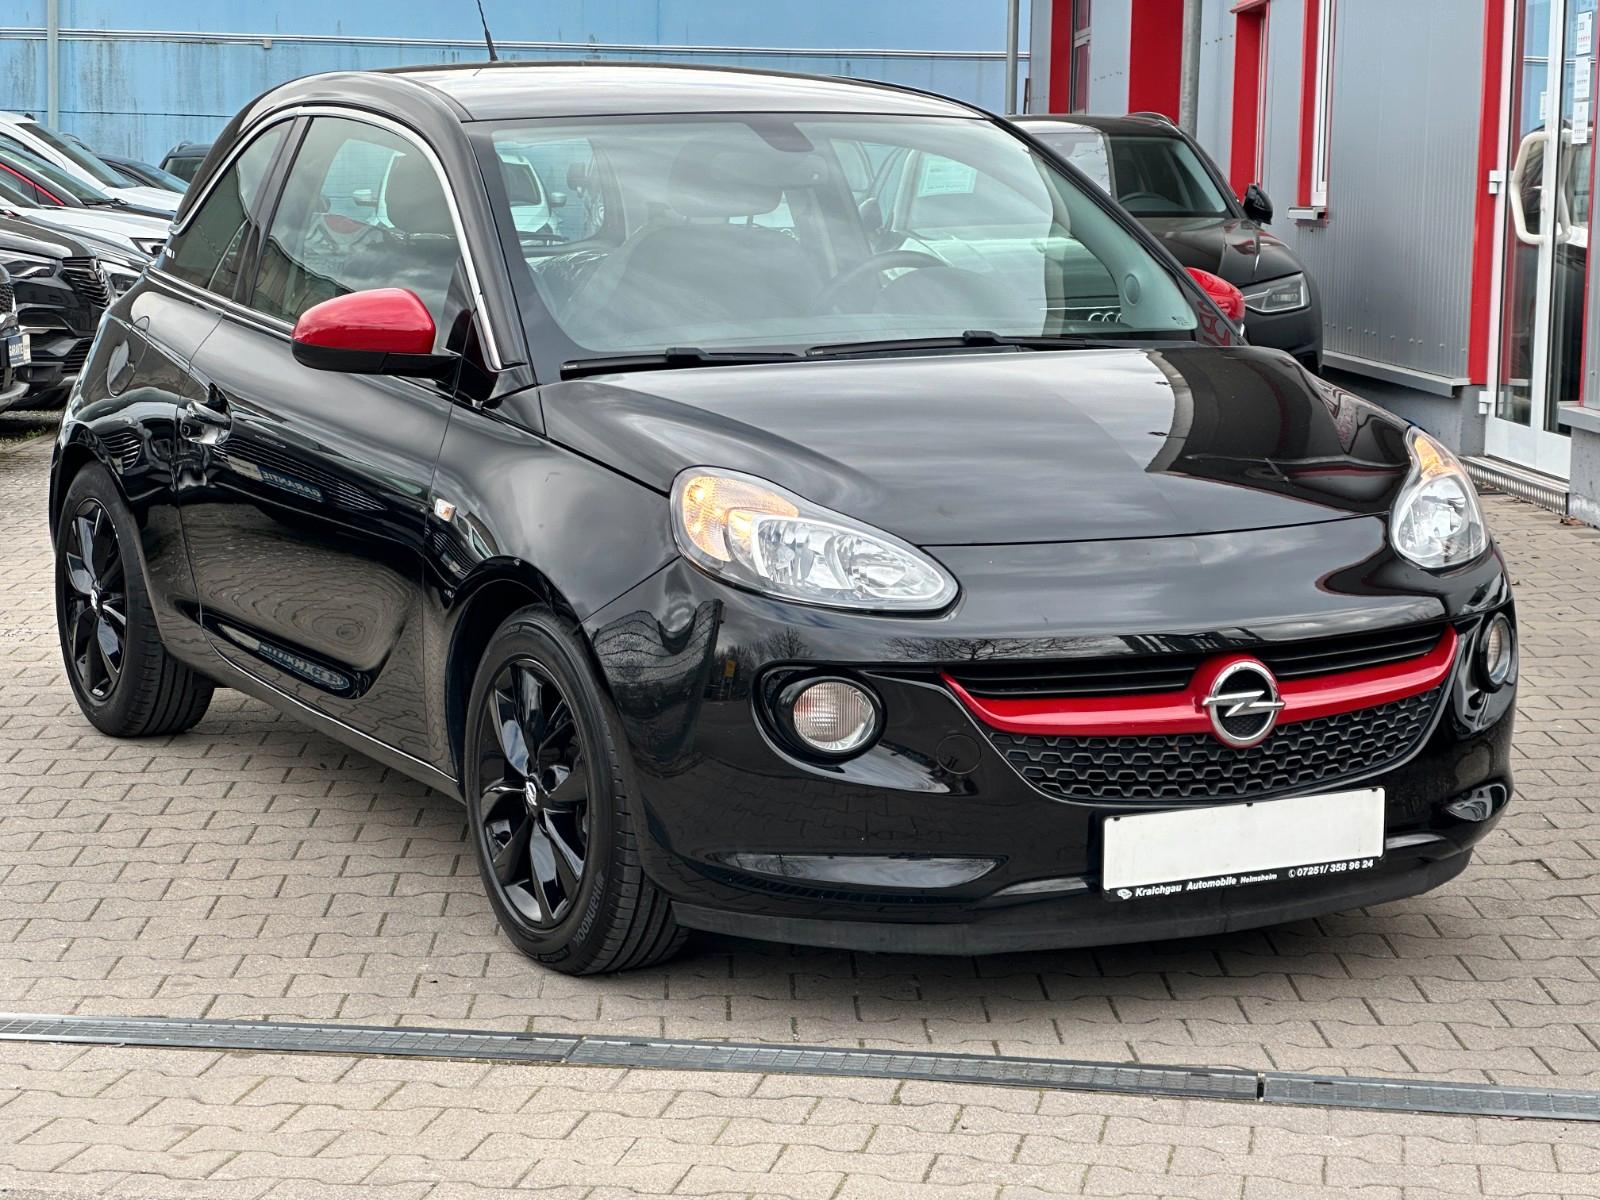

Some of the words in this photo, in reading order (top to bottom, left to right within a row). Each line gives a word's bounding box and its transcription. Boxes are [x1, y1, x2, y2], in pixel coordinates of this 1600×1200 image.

[1330, 862, 1347, 873] 358
[1349, 860, 1360, 870] 96
[1362, 859, 1374, 869] 24
[1135, 884, 1182, 897] Kraichgau
[1186, 877, 1237, 891] Automobile
